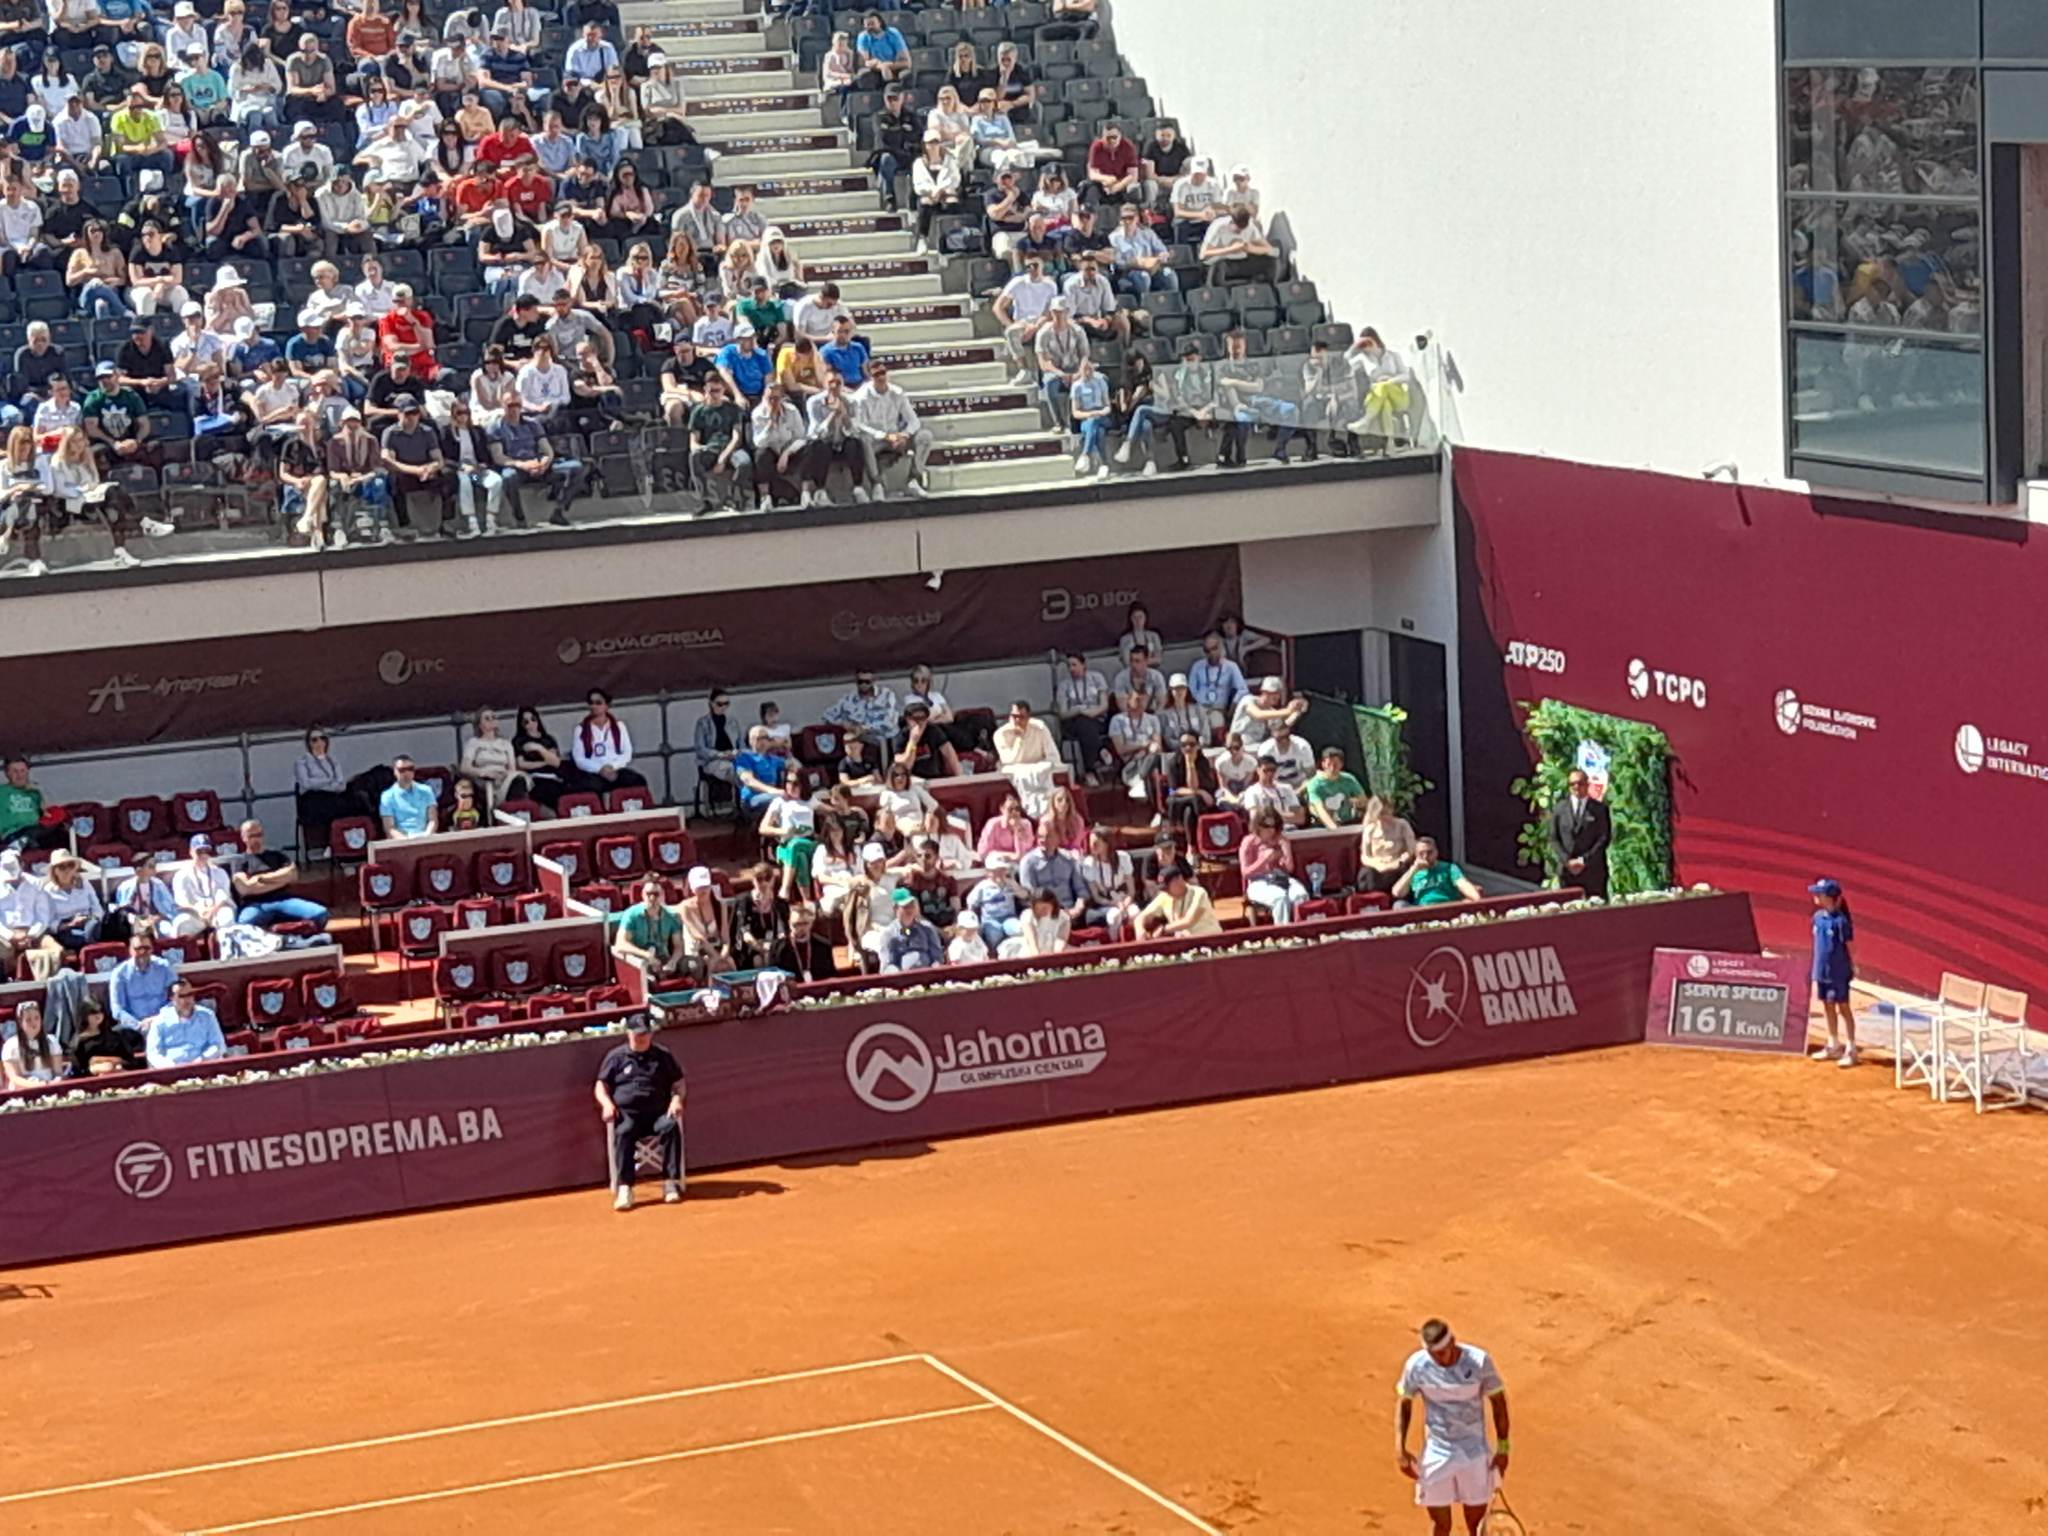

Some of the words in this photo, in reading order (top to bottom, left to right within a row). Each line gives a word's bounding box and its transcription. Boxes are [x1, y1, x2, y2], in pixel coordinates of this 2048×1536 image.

[1472, 946, 1566, 993] NOVA
[1481, 985, 1578, 1026] BANKA
[1684, 983, 1728, 999] SERVE
[1732, 986, 1778, 1001] SPEED
[1680, 1006, 1733, 1034] 161
[1735, 1020, 1780, 1038] Km/h
[934, 1021, 1106, 1072] Jahorina
[186, 1106, 503, 1180] FITNESOPREMA.BA
